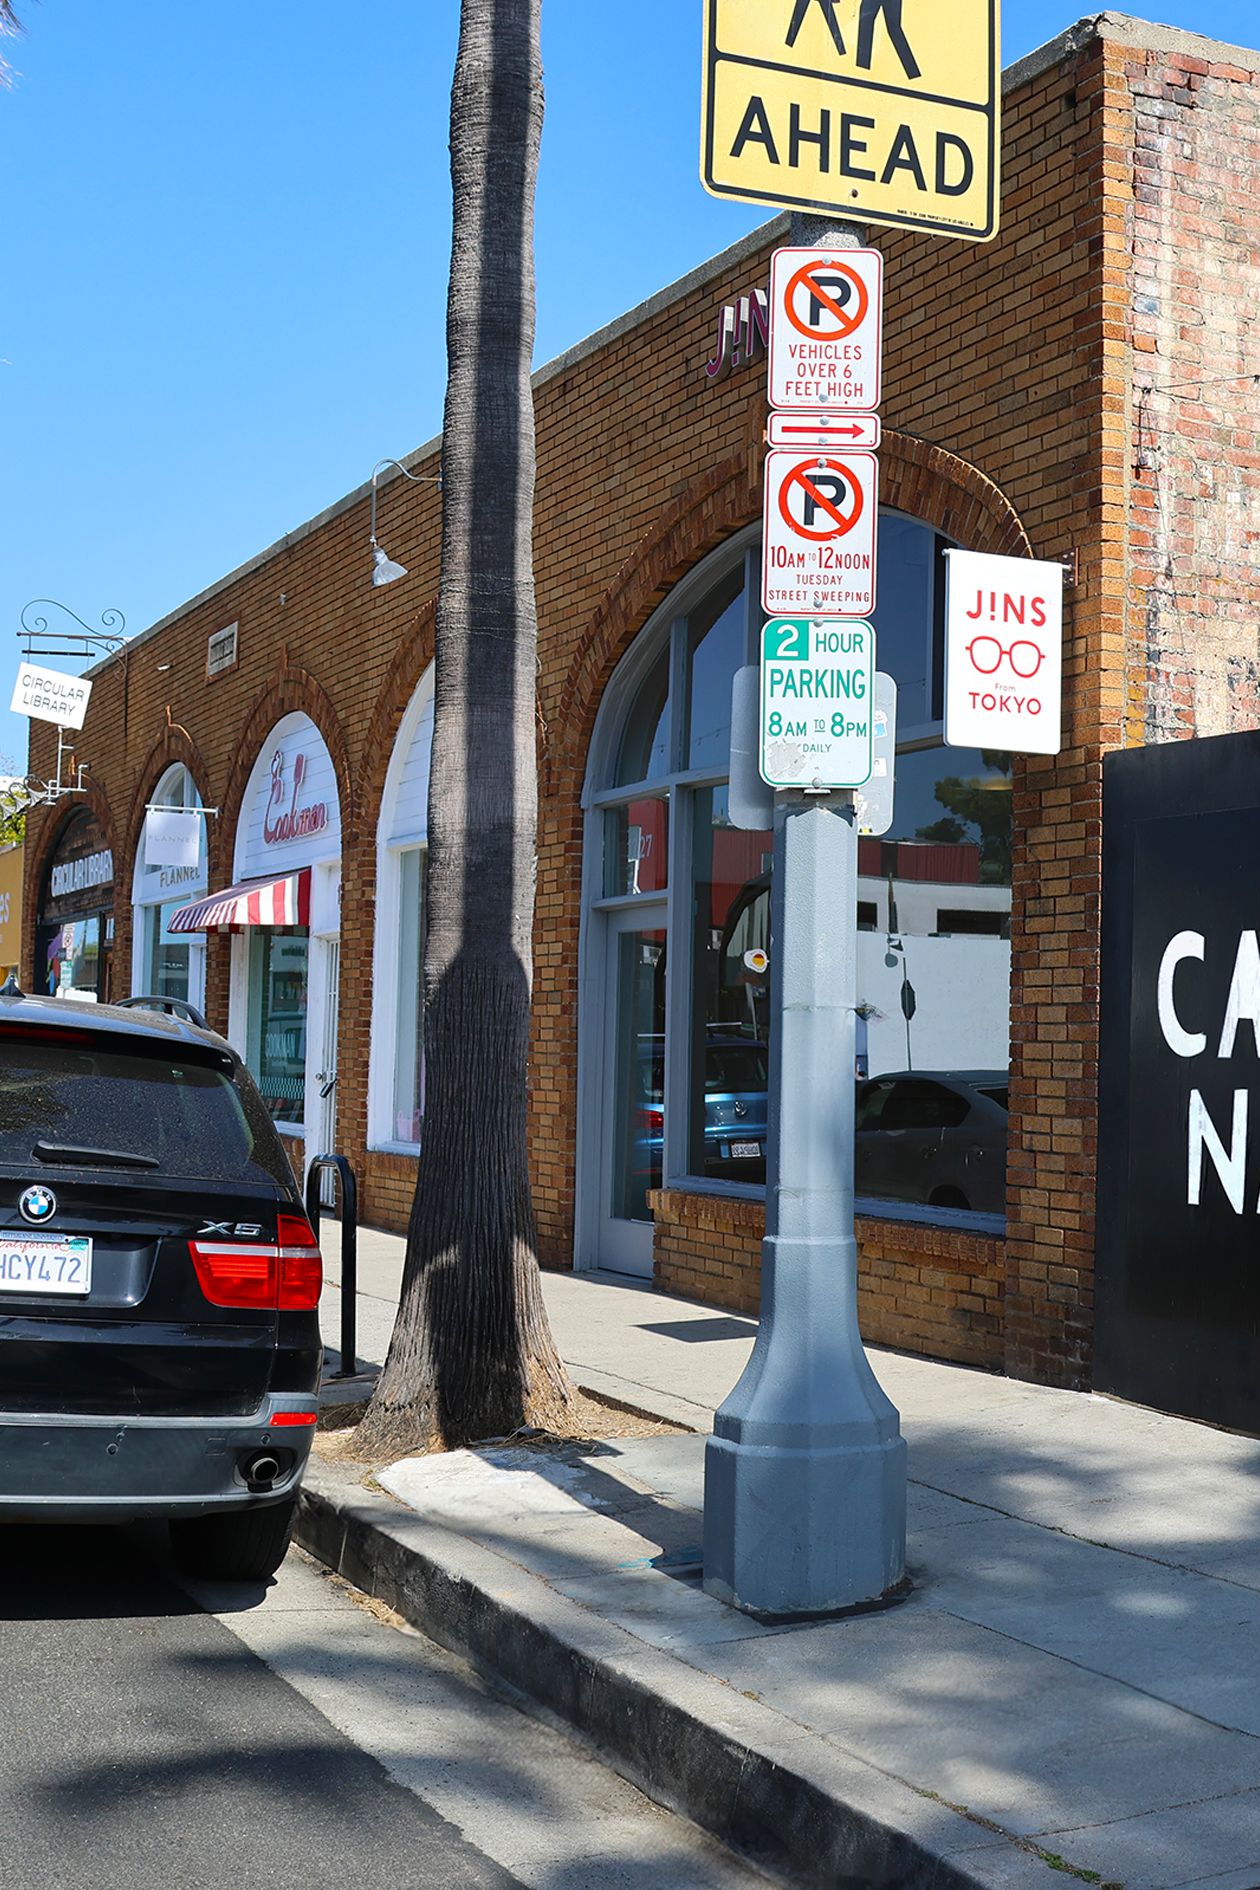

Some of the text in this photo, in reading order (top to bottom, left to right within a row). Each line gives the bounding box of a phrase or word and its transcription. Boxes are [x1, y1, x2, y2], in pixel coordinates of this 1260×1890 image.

[730, 95, 974, 197] AHEAD
[789, 344, 862, 360] VEHICLES
[797, 362, 852, 378] OVER 6
[786, 381, 863, 397] FEET HIGH
[770, 545, 870, 570] 10AM TO 12NOON
[796, 574, 843, 585] TUESDAY
[769, 589, 870, 602] STREET SWEEPING
[776, 624, 864, 657] 2 HOUR
[22, 674, 85, 702] CIRCULAR
[769, 669, 866, 699] PARKING
[995, 683, 1016, 693] From
[23, 692, 76, 716] LIBRARY
[969, 692, 1041, 715] TOKYO
[769, 711, 867, 737] 8AM TO 8PM
[803, 743, 832, 753] DAILY
[197, 1220, 262, 1236] X5
